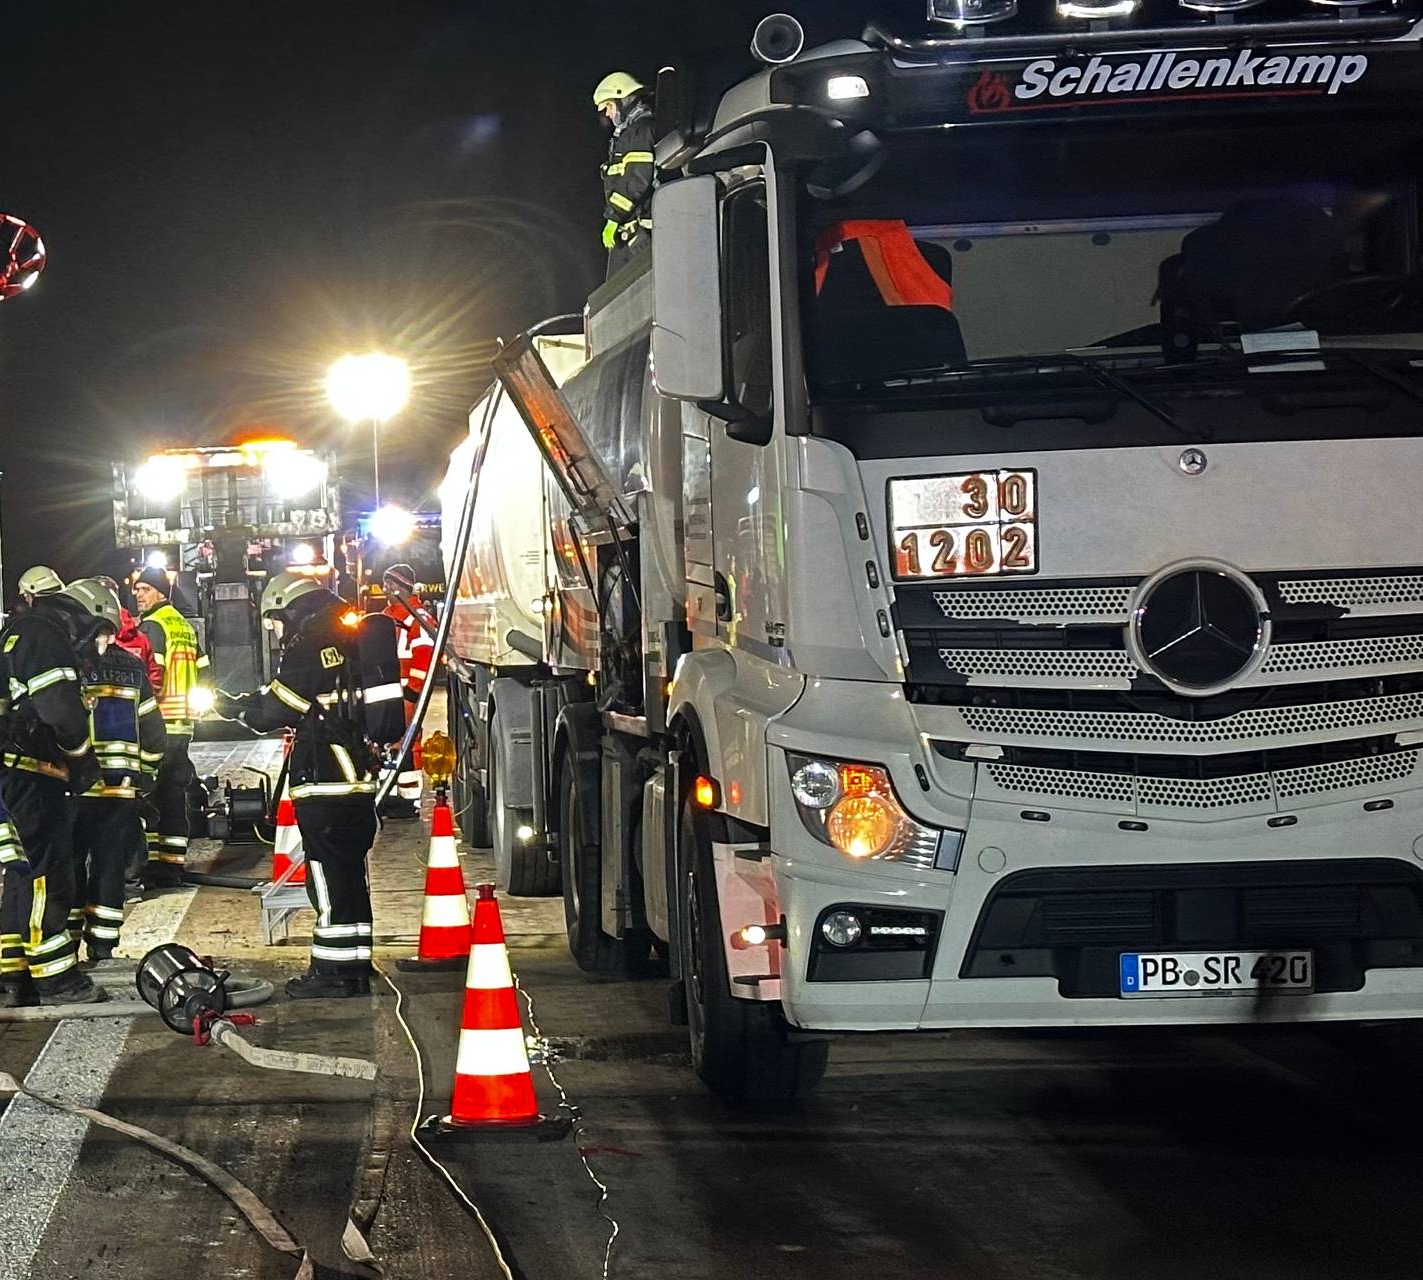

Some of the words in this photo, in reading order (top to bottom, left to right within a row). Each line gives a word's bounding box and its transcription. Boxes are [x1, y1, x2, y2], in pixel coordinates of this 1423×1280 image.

[1014, 48, 1369, 101] Schallenkamp
[961, 474, 1027, 519] 30
[900, 526, 1030, 574] 1202
[1140, 957, 1178, 986] PB
[1203, 956, 1242, 985] SR
[1250, 955, 1308, 984] 420
